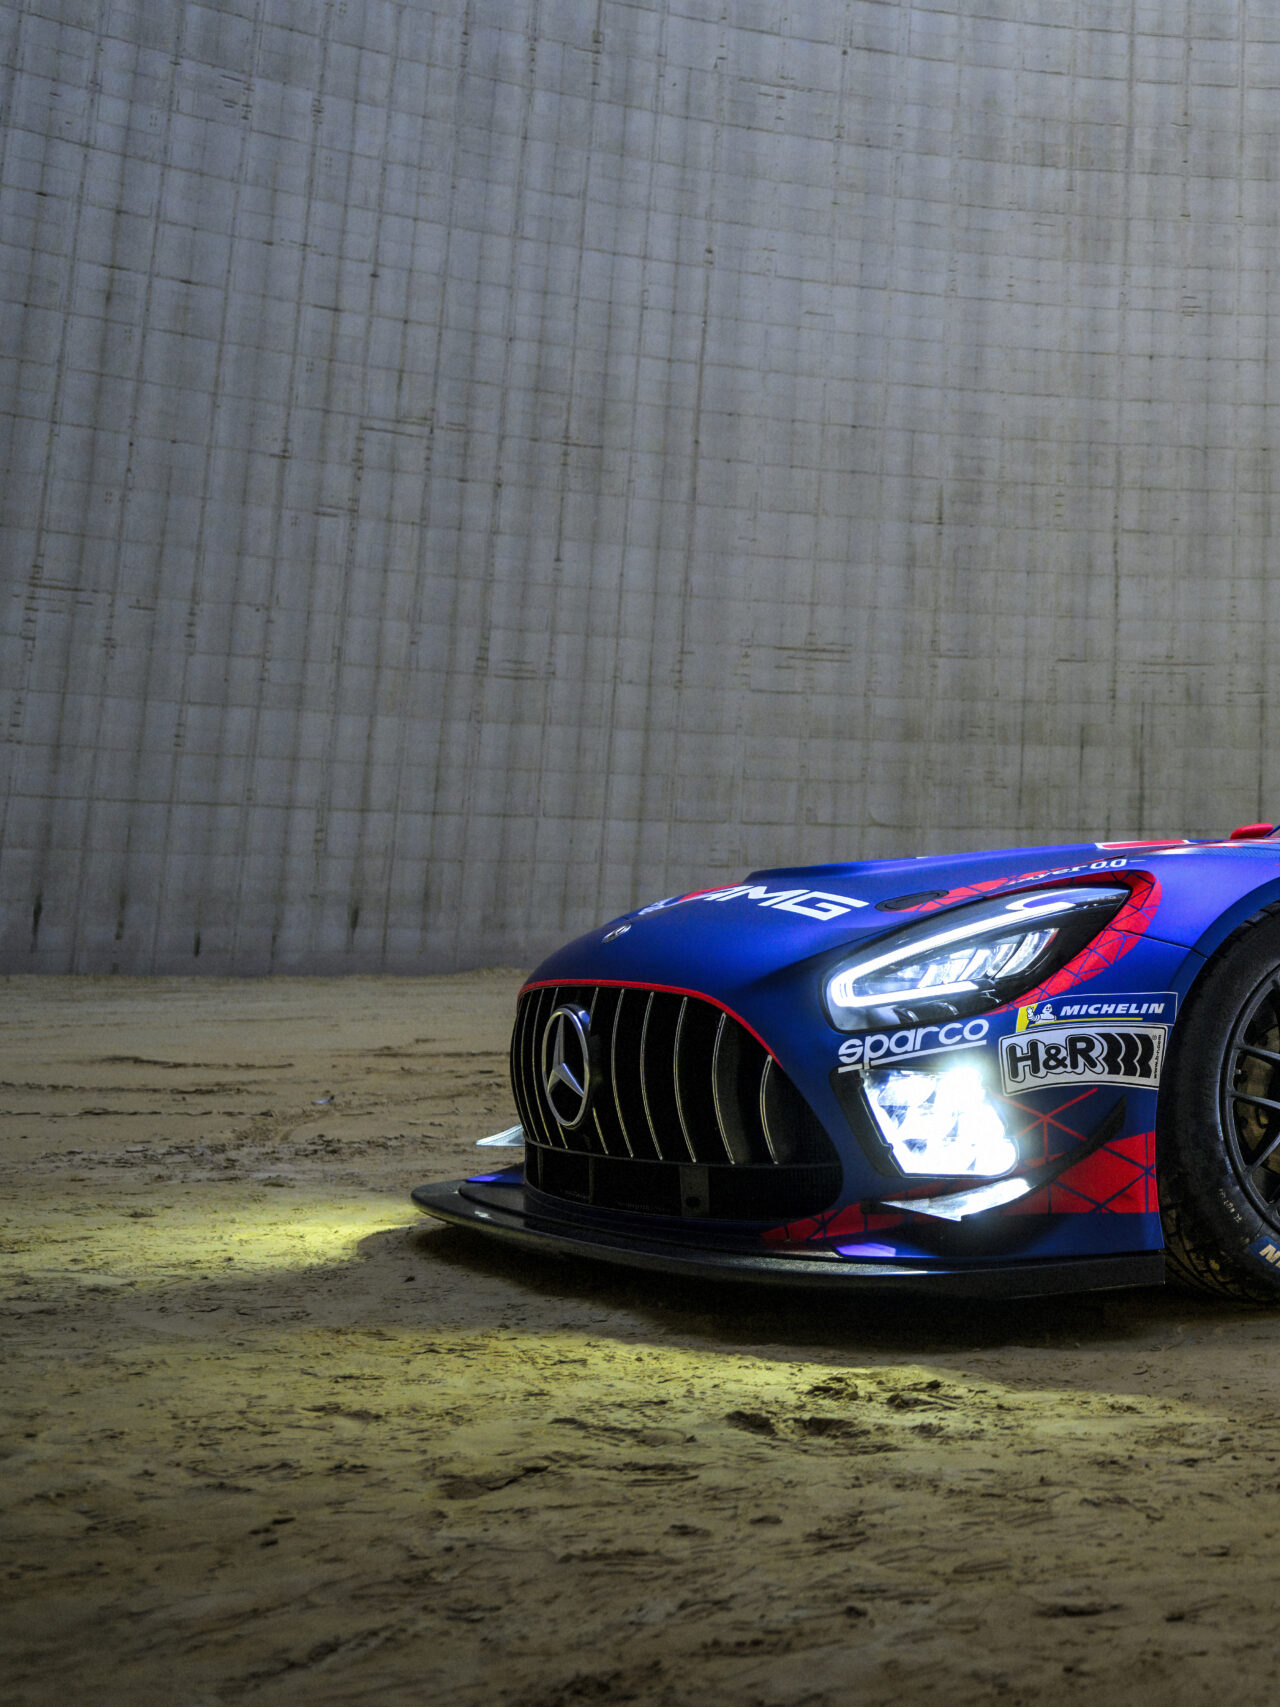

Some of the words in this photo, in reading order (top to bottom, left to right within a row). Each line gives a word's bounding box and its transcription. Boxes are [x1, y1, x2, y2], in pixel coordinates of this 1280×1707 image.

[1060, 1003, 1165, 1016] MICHELIN
[838, 1018, 989, 1069] sparco
[1007, 1034, 1102, 1081] H&R
